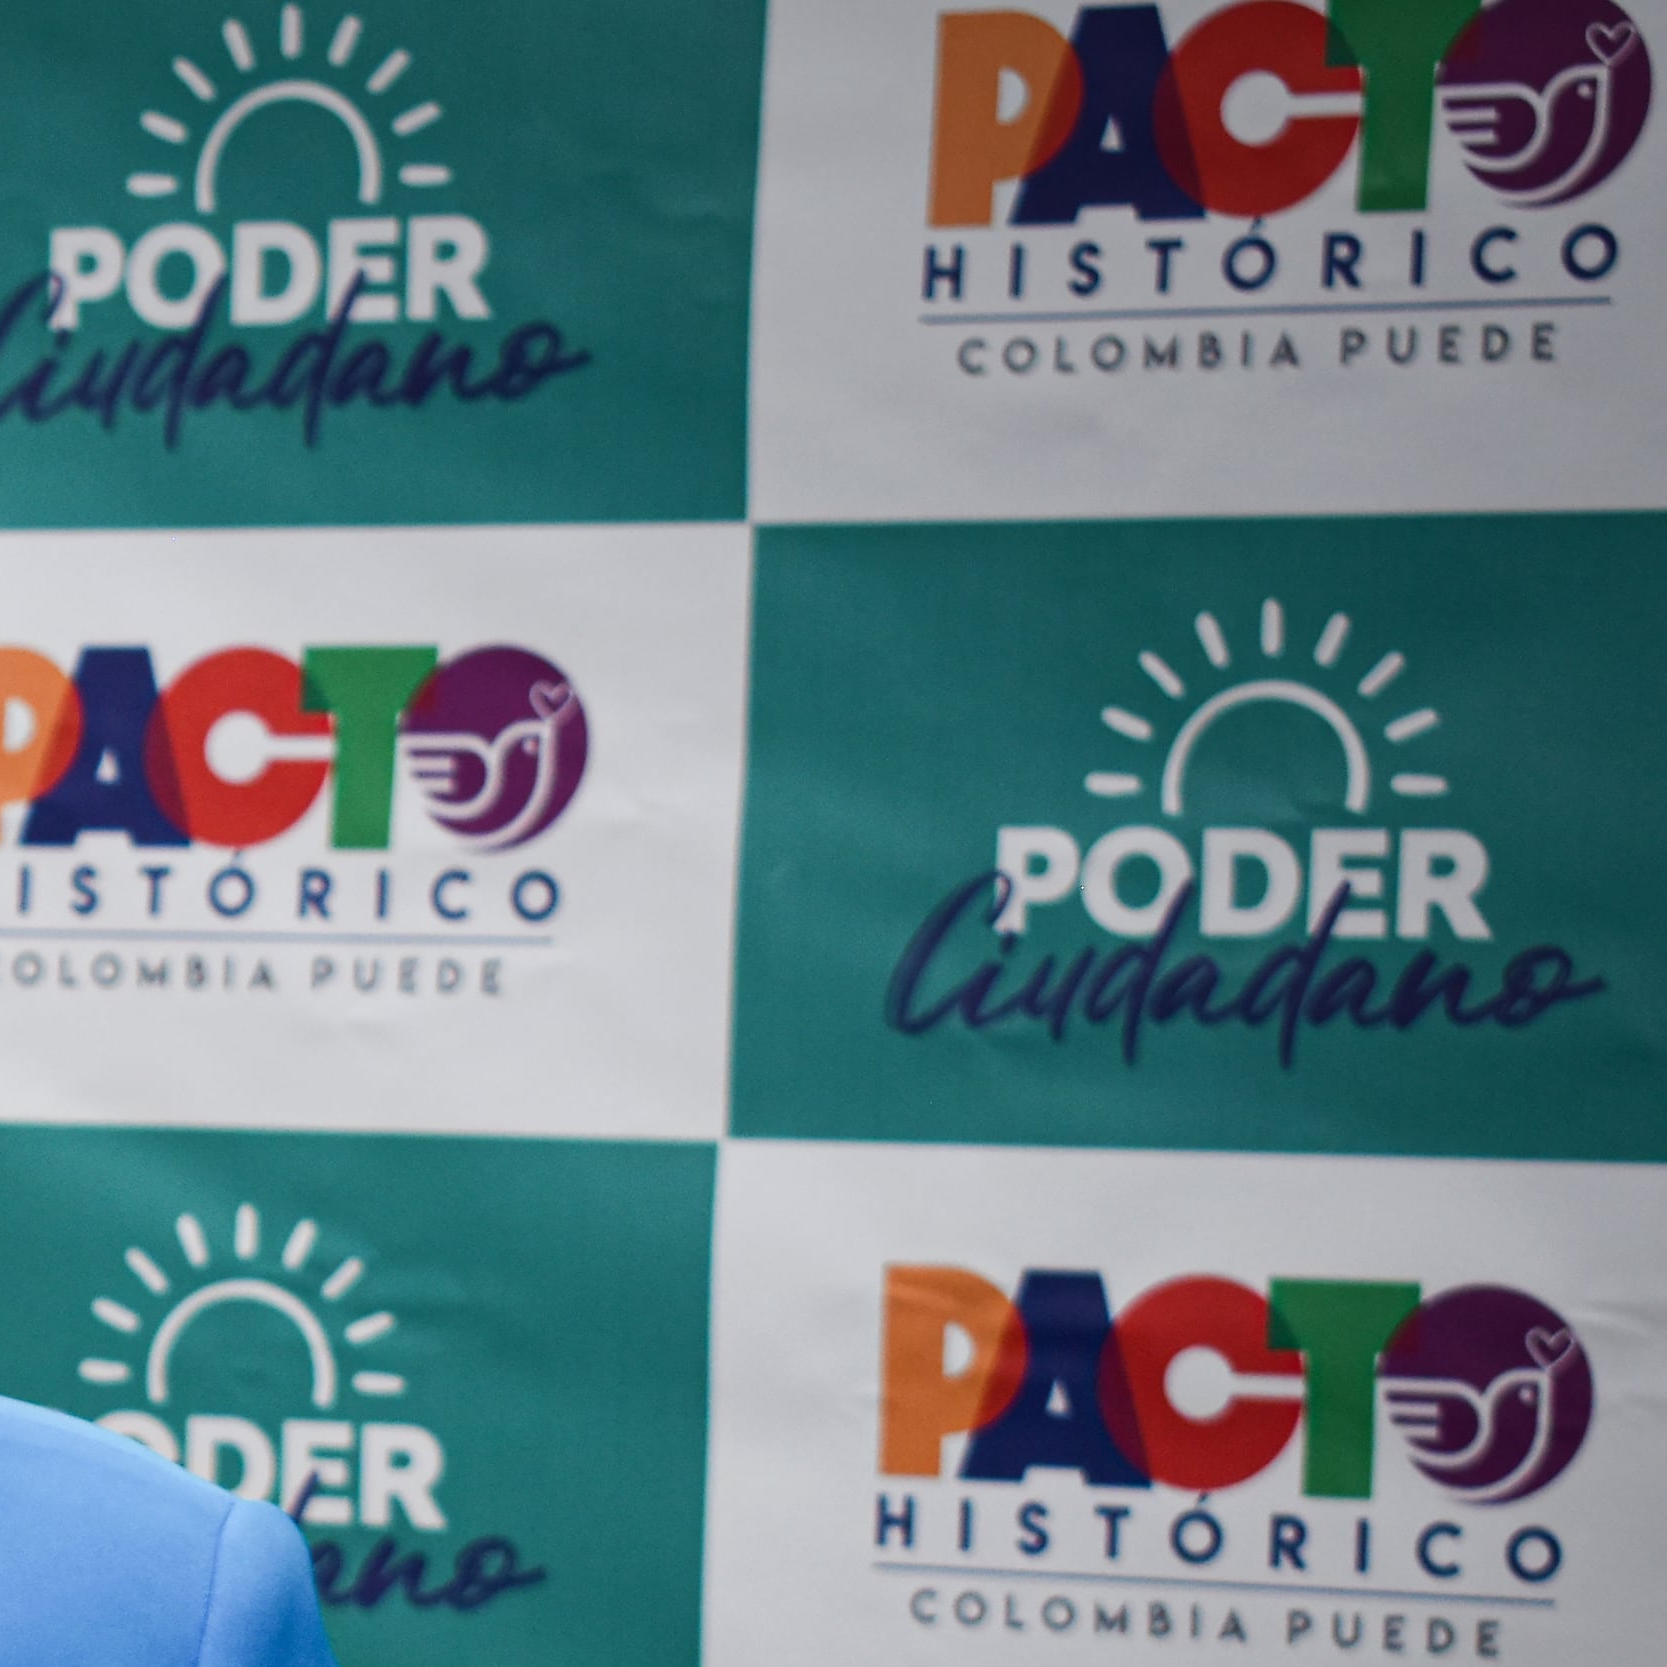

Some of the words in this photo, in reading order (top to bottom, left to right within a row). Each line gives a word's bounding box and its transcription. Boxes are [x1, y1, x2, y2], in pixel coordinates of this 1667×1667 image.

[927, 0, 1652, 228] PACTO
[49, 214, 491, 331] PODER
[922, 219, 1618, 300] HISTÓRICO
[957, 330, 1299, 376] COLOMBIA
[1339, 322, 1559, 366] PUEDE
[995, 825, 1492, 940] PODER
[312, 955, 504, 996] PUEDE
[886, 870, 1607, 1068] Ciudadano
[878, 1263, 1593, 1507] PACTO
[92, 1411, 446, 1530] DER
[874, 1494, 1563, 1583] HISTÓRICO
[910, 1589, 1249, 1643] COLOMBIA
[1286, 1612, 1501, 1659] PUEDE
